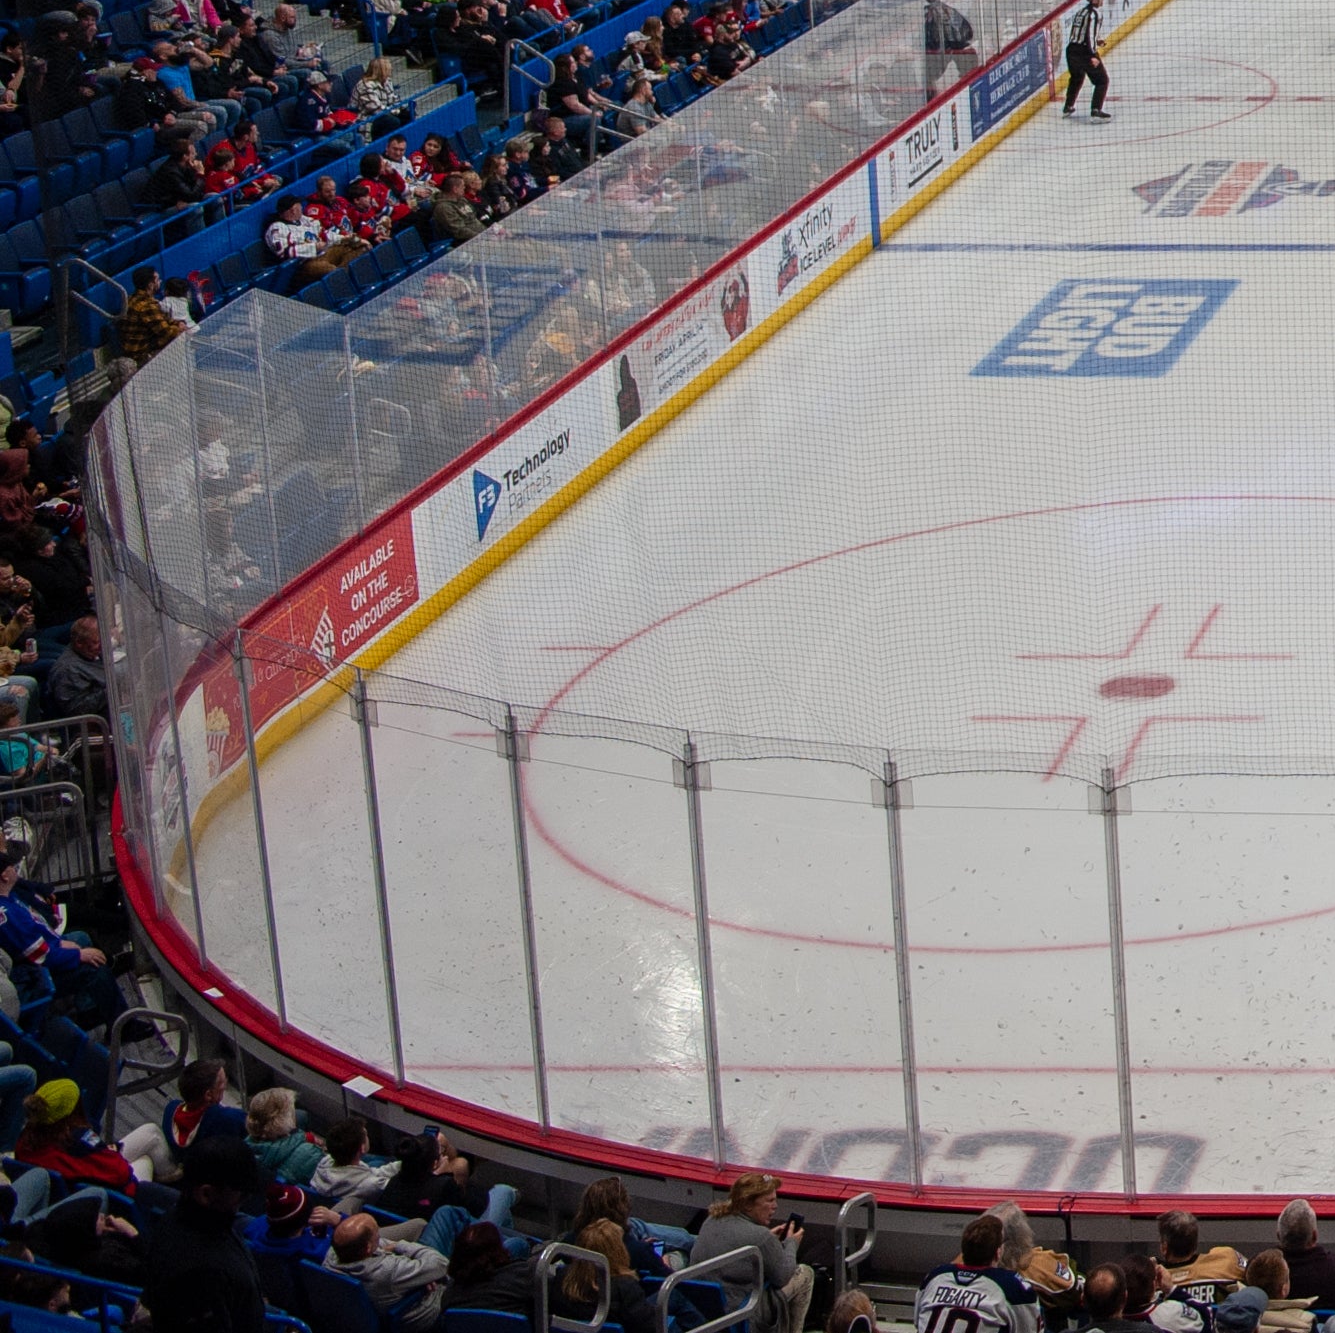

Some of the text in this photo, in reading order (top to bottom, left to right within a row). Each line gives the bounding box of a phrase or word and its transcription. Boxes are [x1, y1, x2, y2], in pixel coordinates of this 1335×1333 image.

[904, 117, 942, 163] TRULY
[1002, 283, 1143, 371] LIGHT
[1094, 295, 1206, 358] BUD
[504, 427, 572, 492] Technology
[477, 484, 496, 513] F3
[507, 470, 552, 514] Partners
[339, 538, 395, 595] AVAILABLE
[350, 571, 389, 613] ON THE
[341, 591, 404, 647] CONCOURSE
[931, 1288, 987, 1310] FOGARTY
